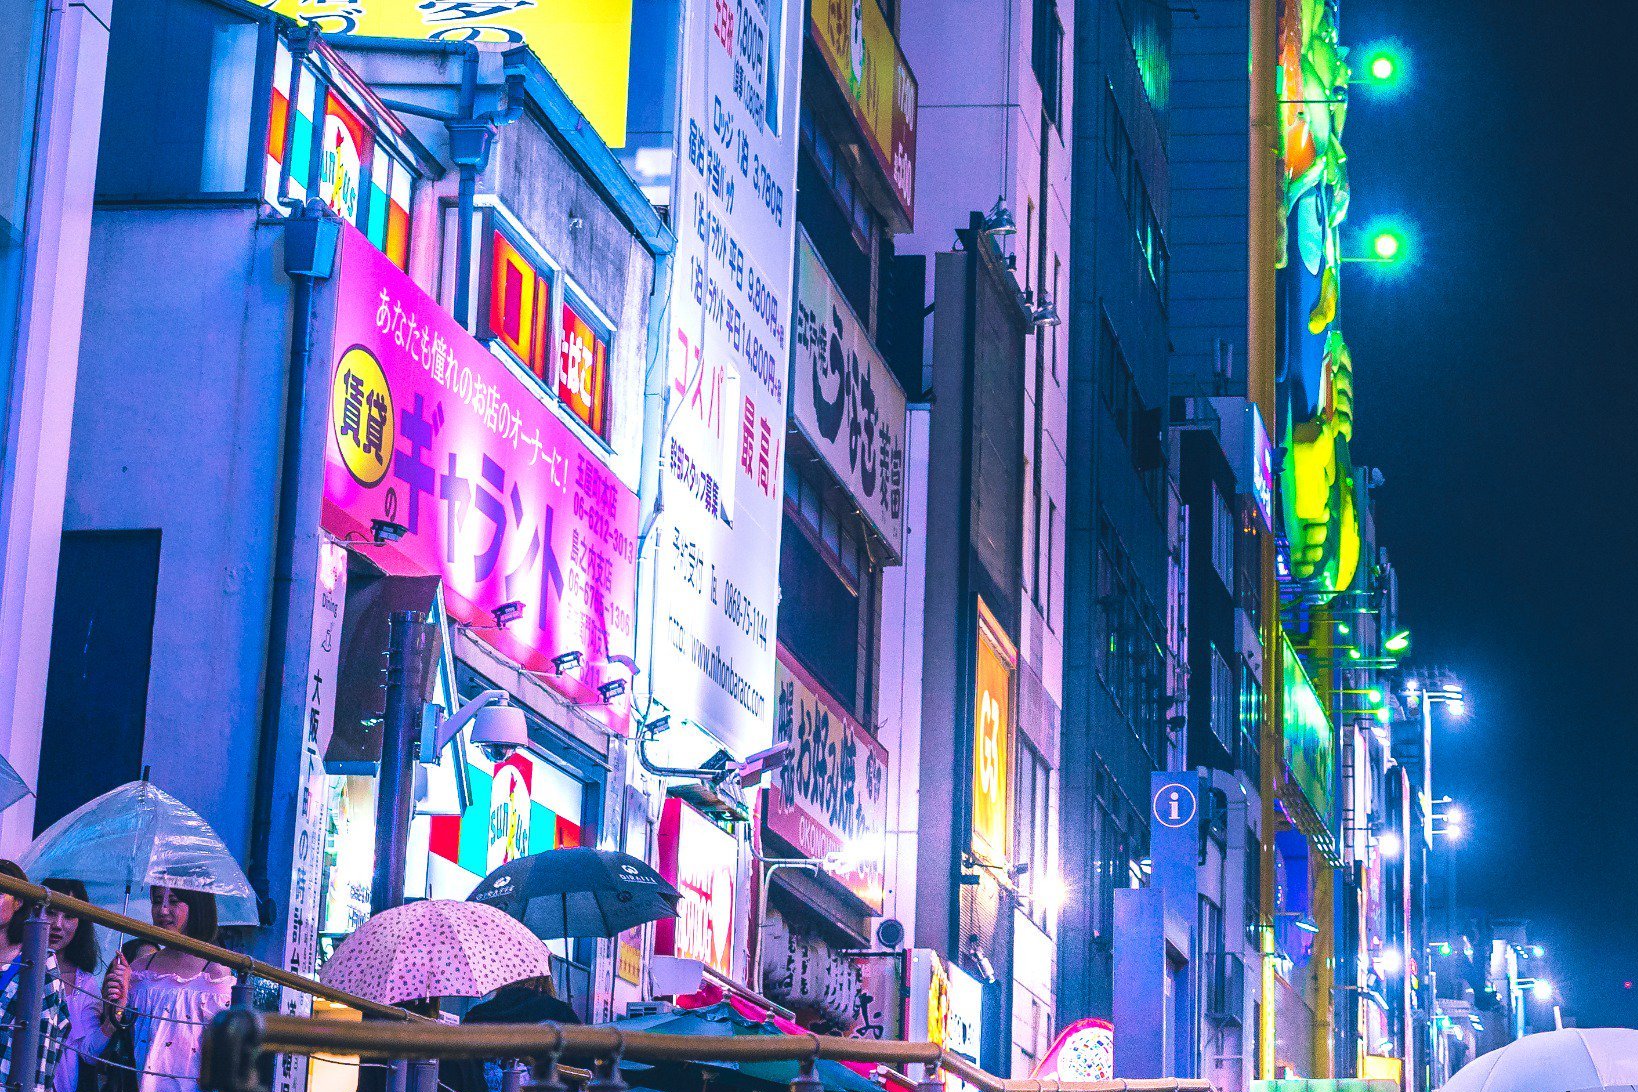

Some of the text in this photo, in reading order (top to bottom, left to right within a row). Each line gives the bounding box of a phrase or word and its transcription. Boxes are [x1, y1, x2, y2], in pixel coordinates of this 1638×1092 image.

[340, 368, 388, 467] 賃貸
[385, 487, 397, 523] の
[394, 392, 565, 632] ギャラント
[812, 304, 878, 498] うなぎ
